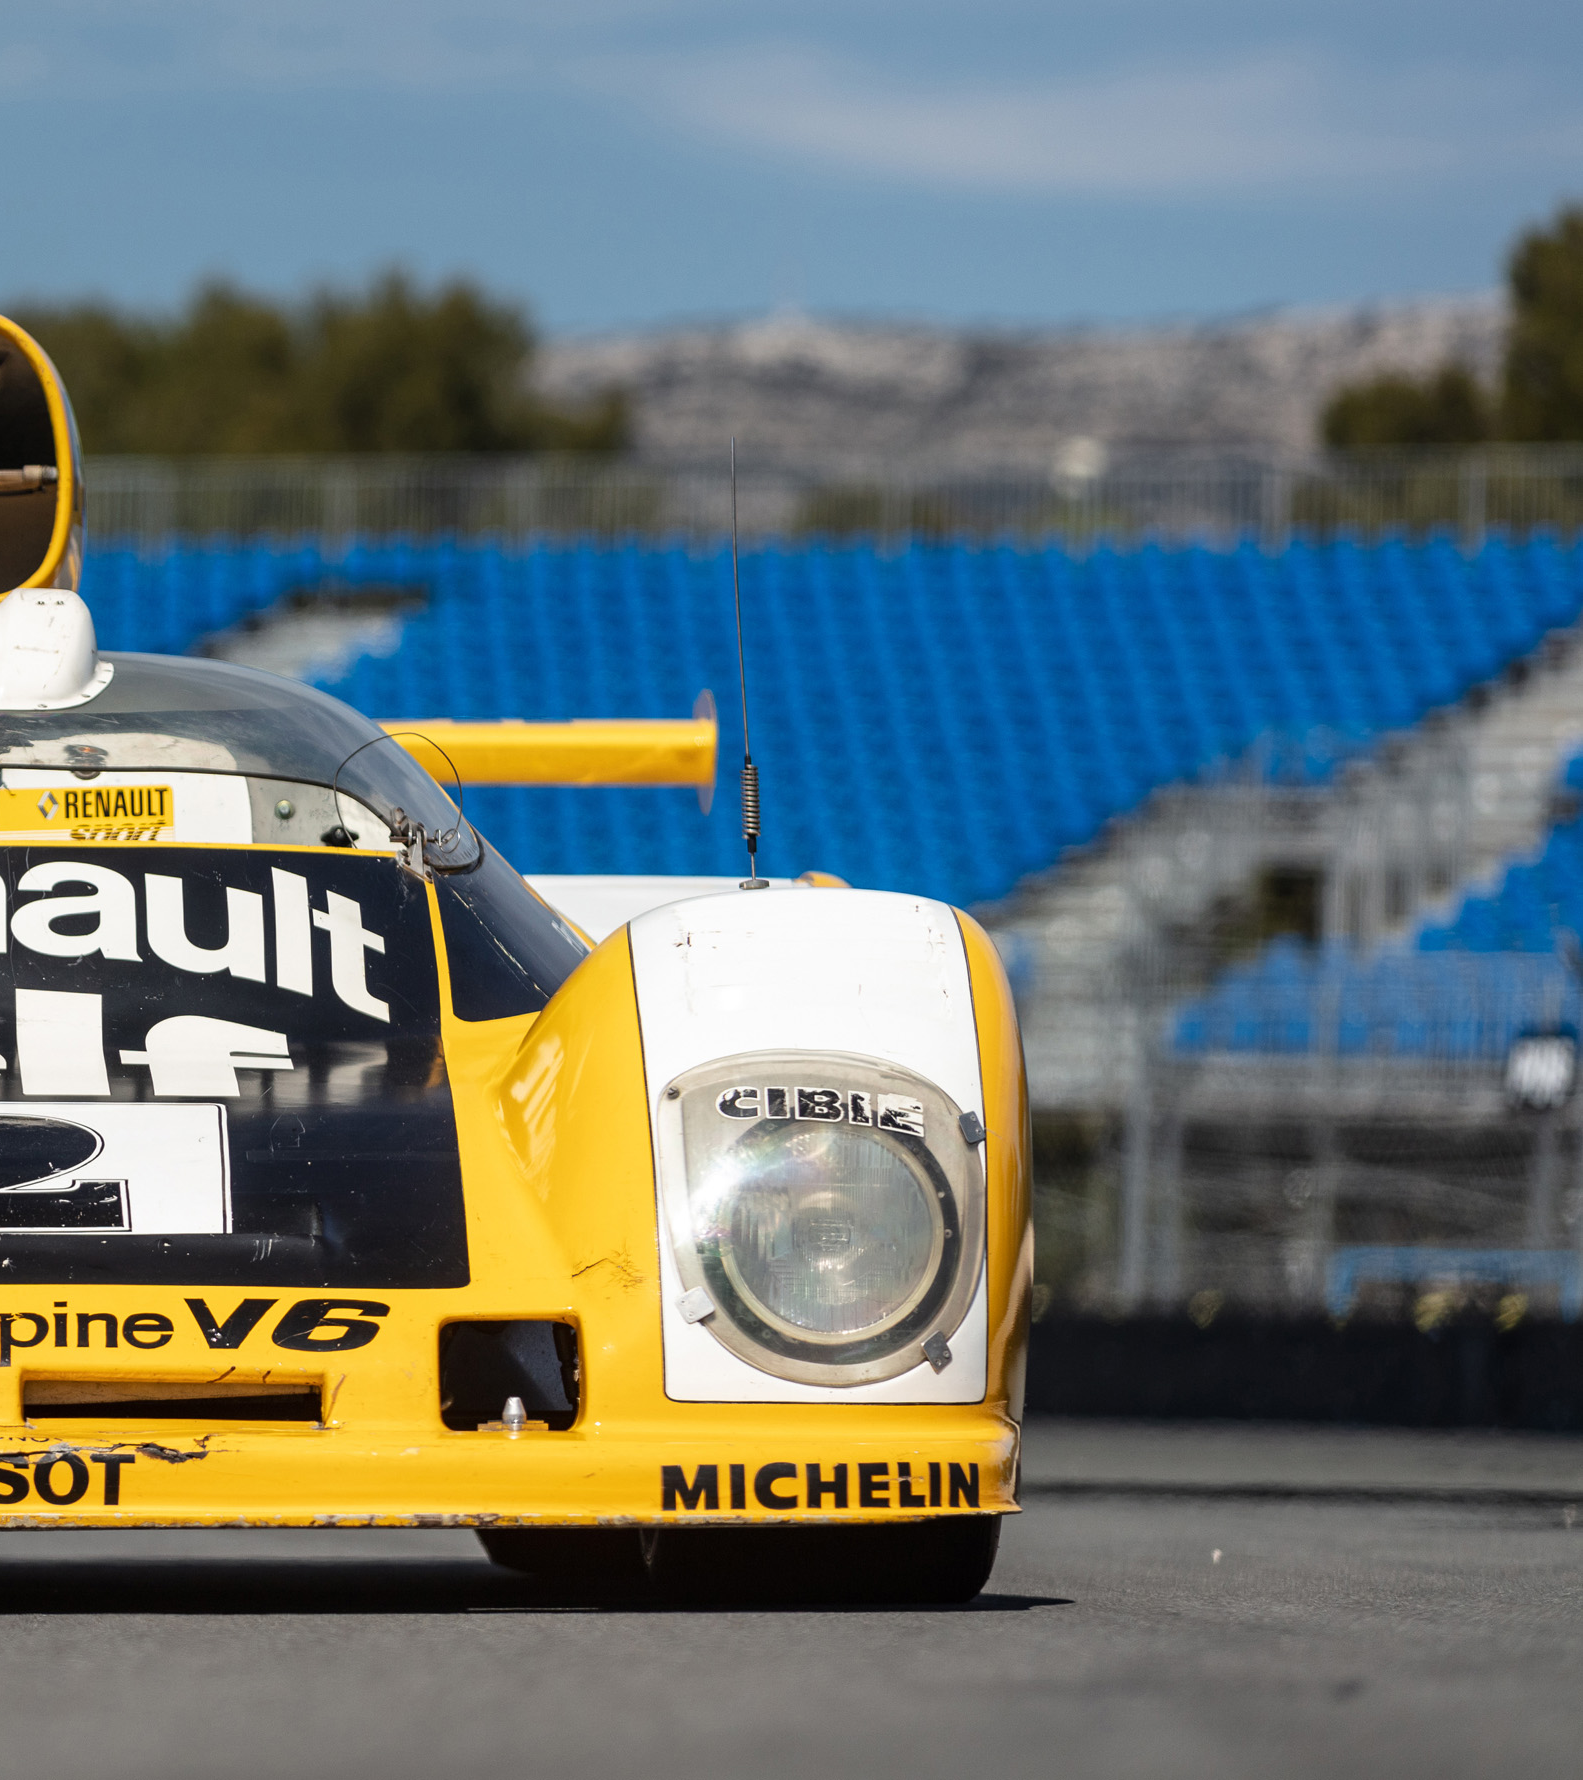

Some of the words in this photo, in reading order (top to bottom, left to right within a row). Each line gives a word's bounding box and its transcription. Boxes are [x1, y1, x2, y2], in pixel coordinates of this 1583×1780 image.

[64, 788, 168, 819] RENAULT
[184, 1298, 391, 1352] V6
[662, 1462, 980, 1511] MICHELIN
